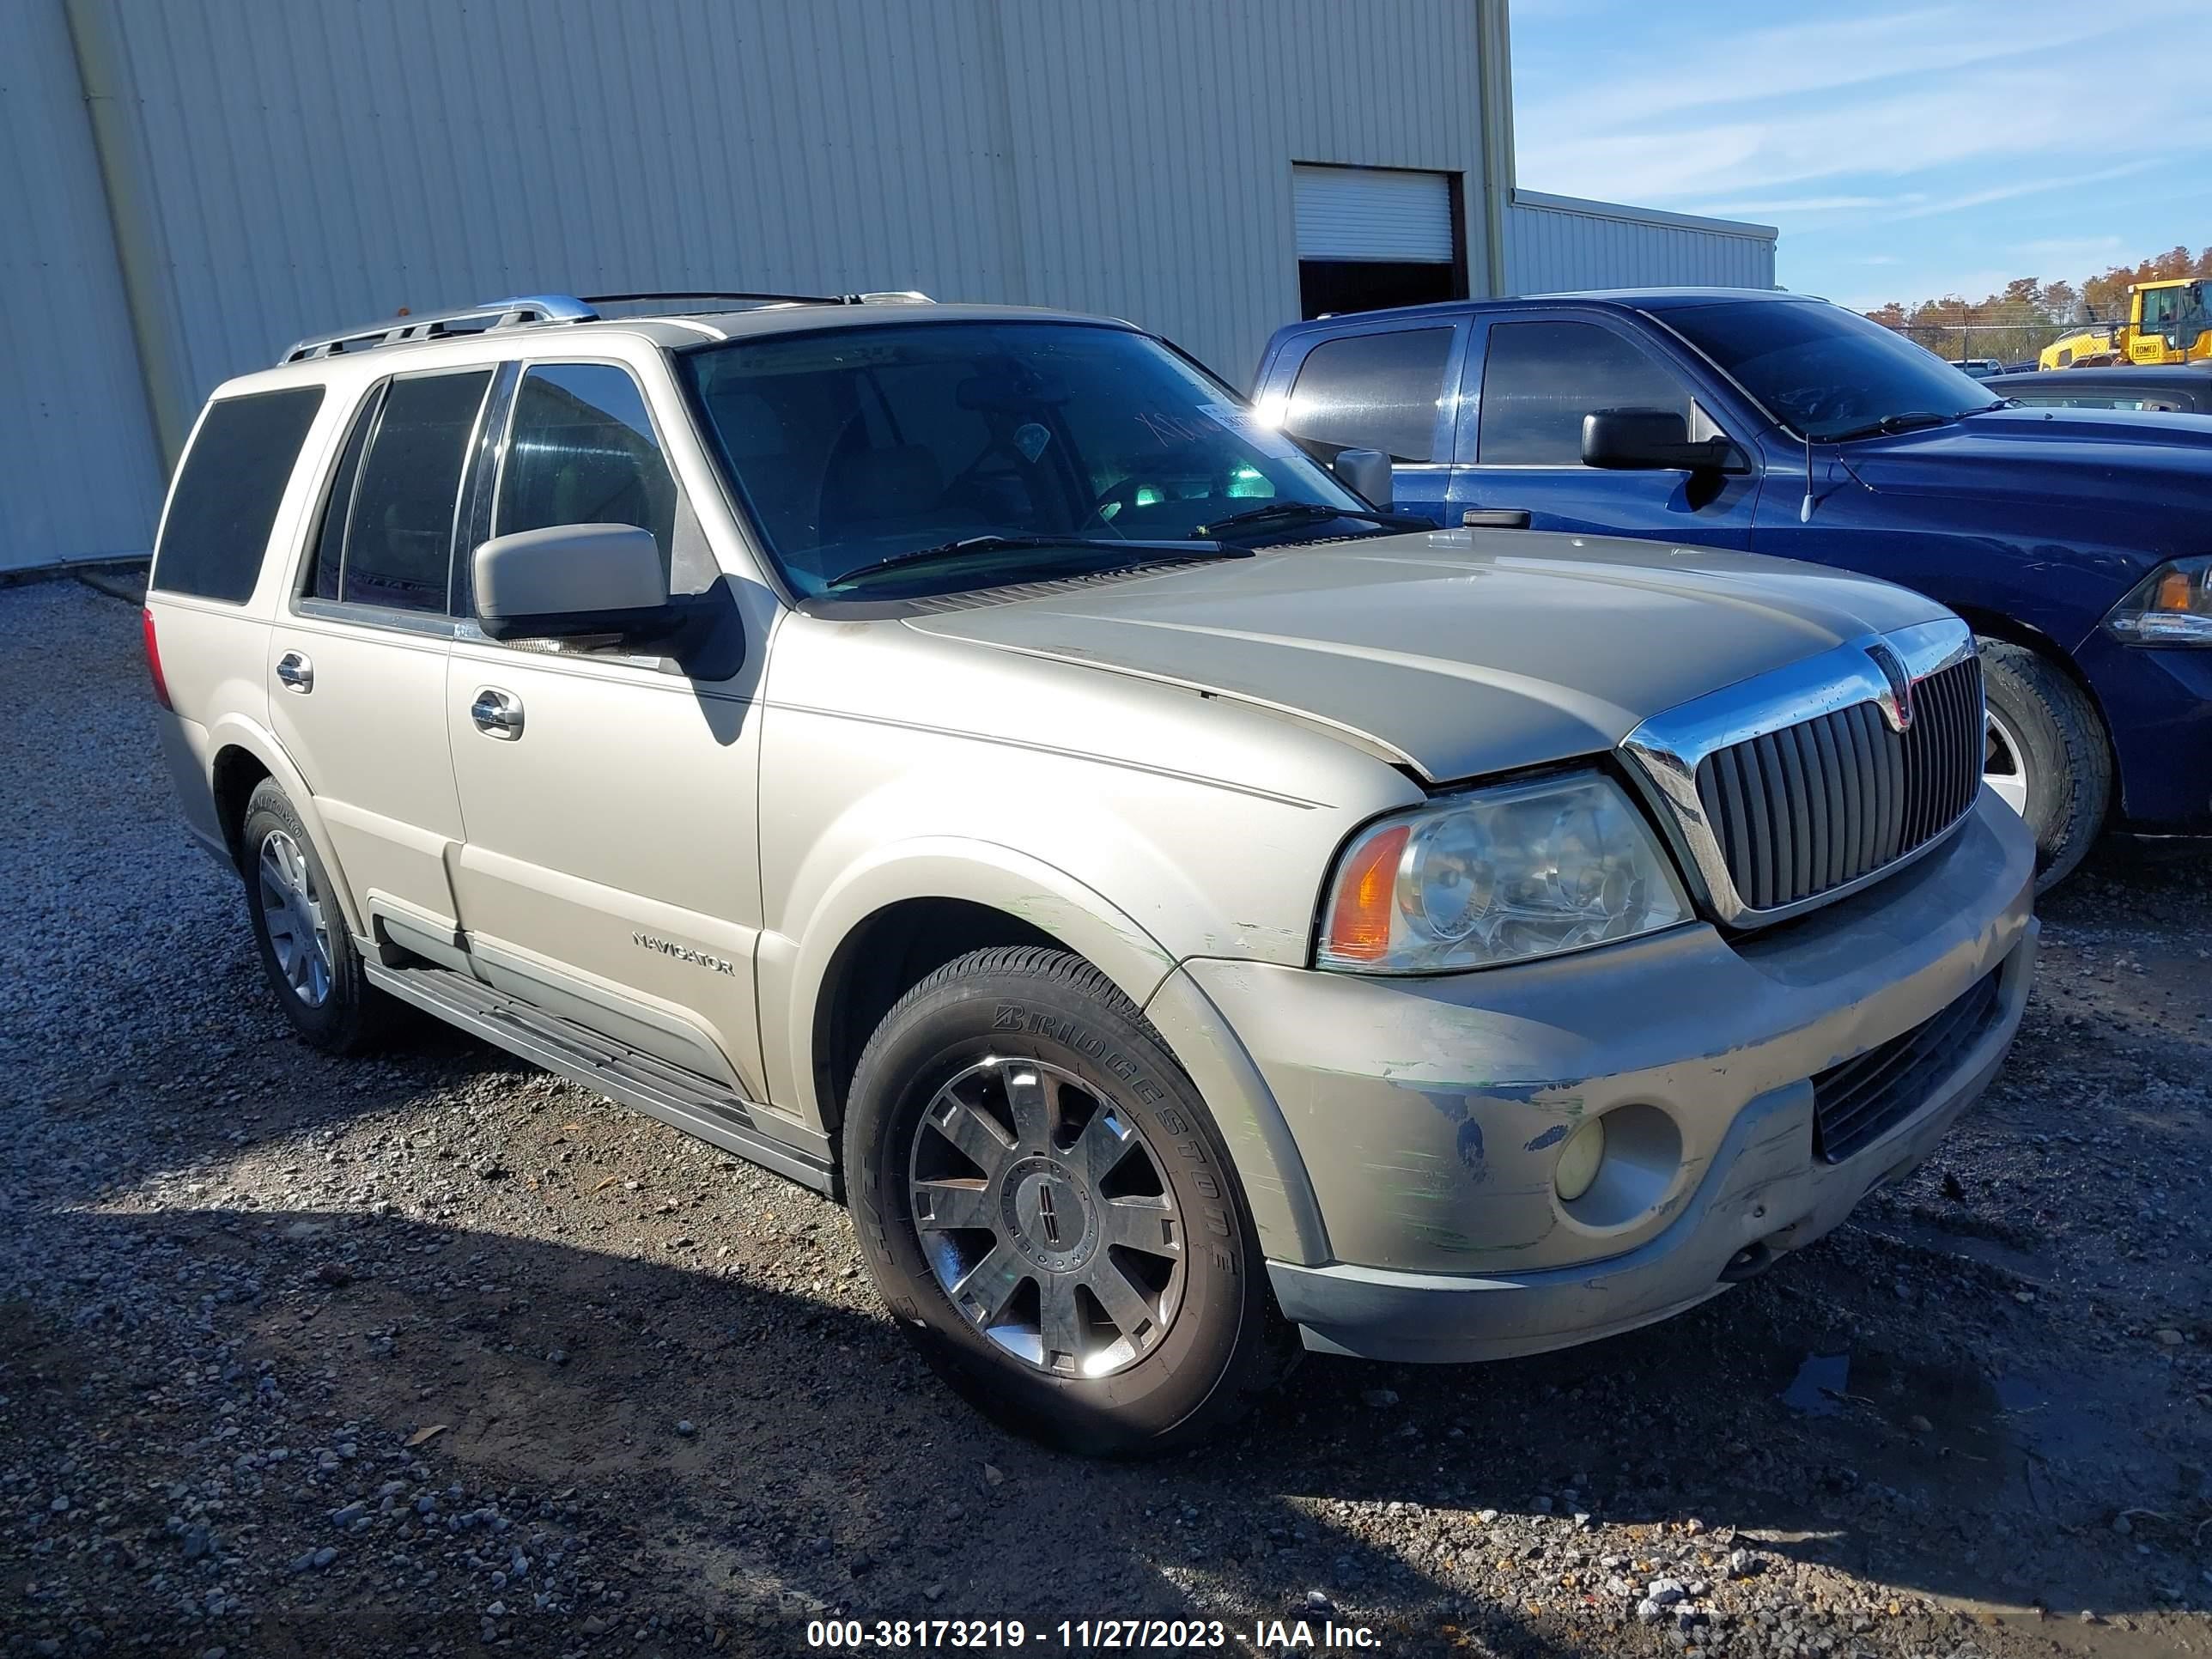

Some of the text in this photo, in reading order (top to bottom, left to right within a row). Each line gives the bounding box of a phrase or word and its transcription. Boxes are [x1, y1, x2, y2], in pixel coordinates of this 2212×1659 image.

[2136, 345, 2156, 354] ROMCO
[632, 931, 735, 977] NAVIGATOR
[992, 1004, 1237, 1276] BRIDGESTONE
[1003, 1160, 1089, 1203] LINCOLN
